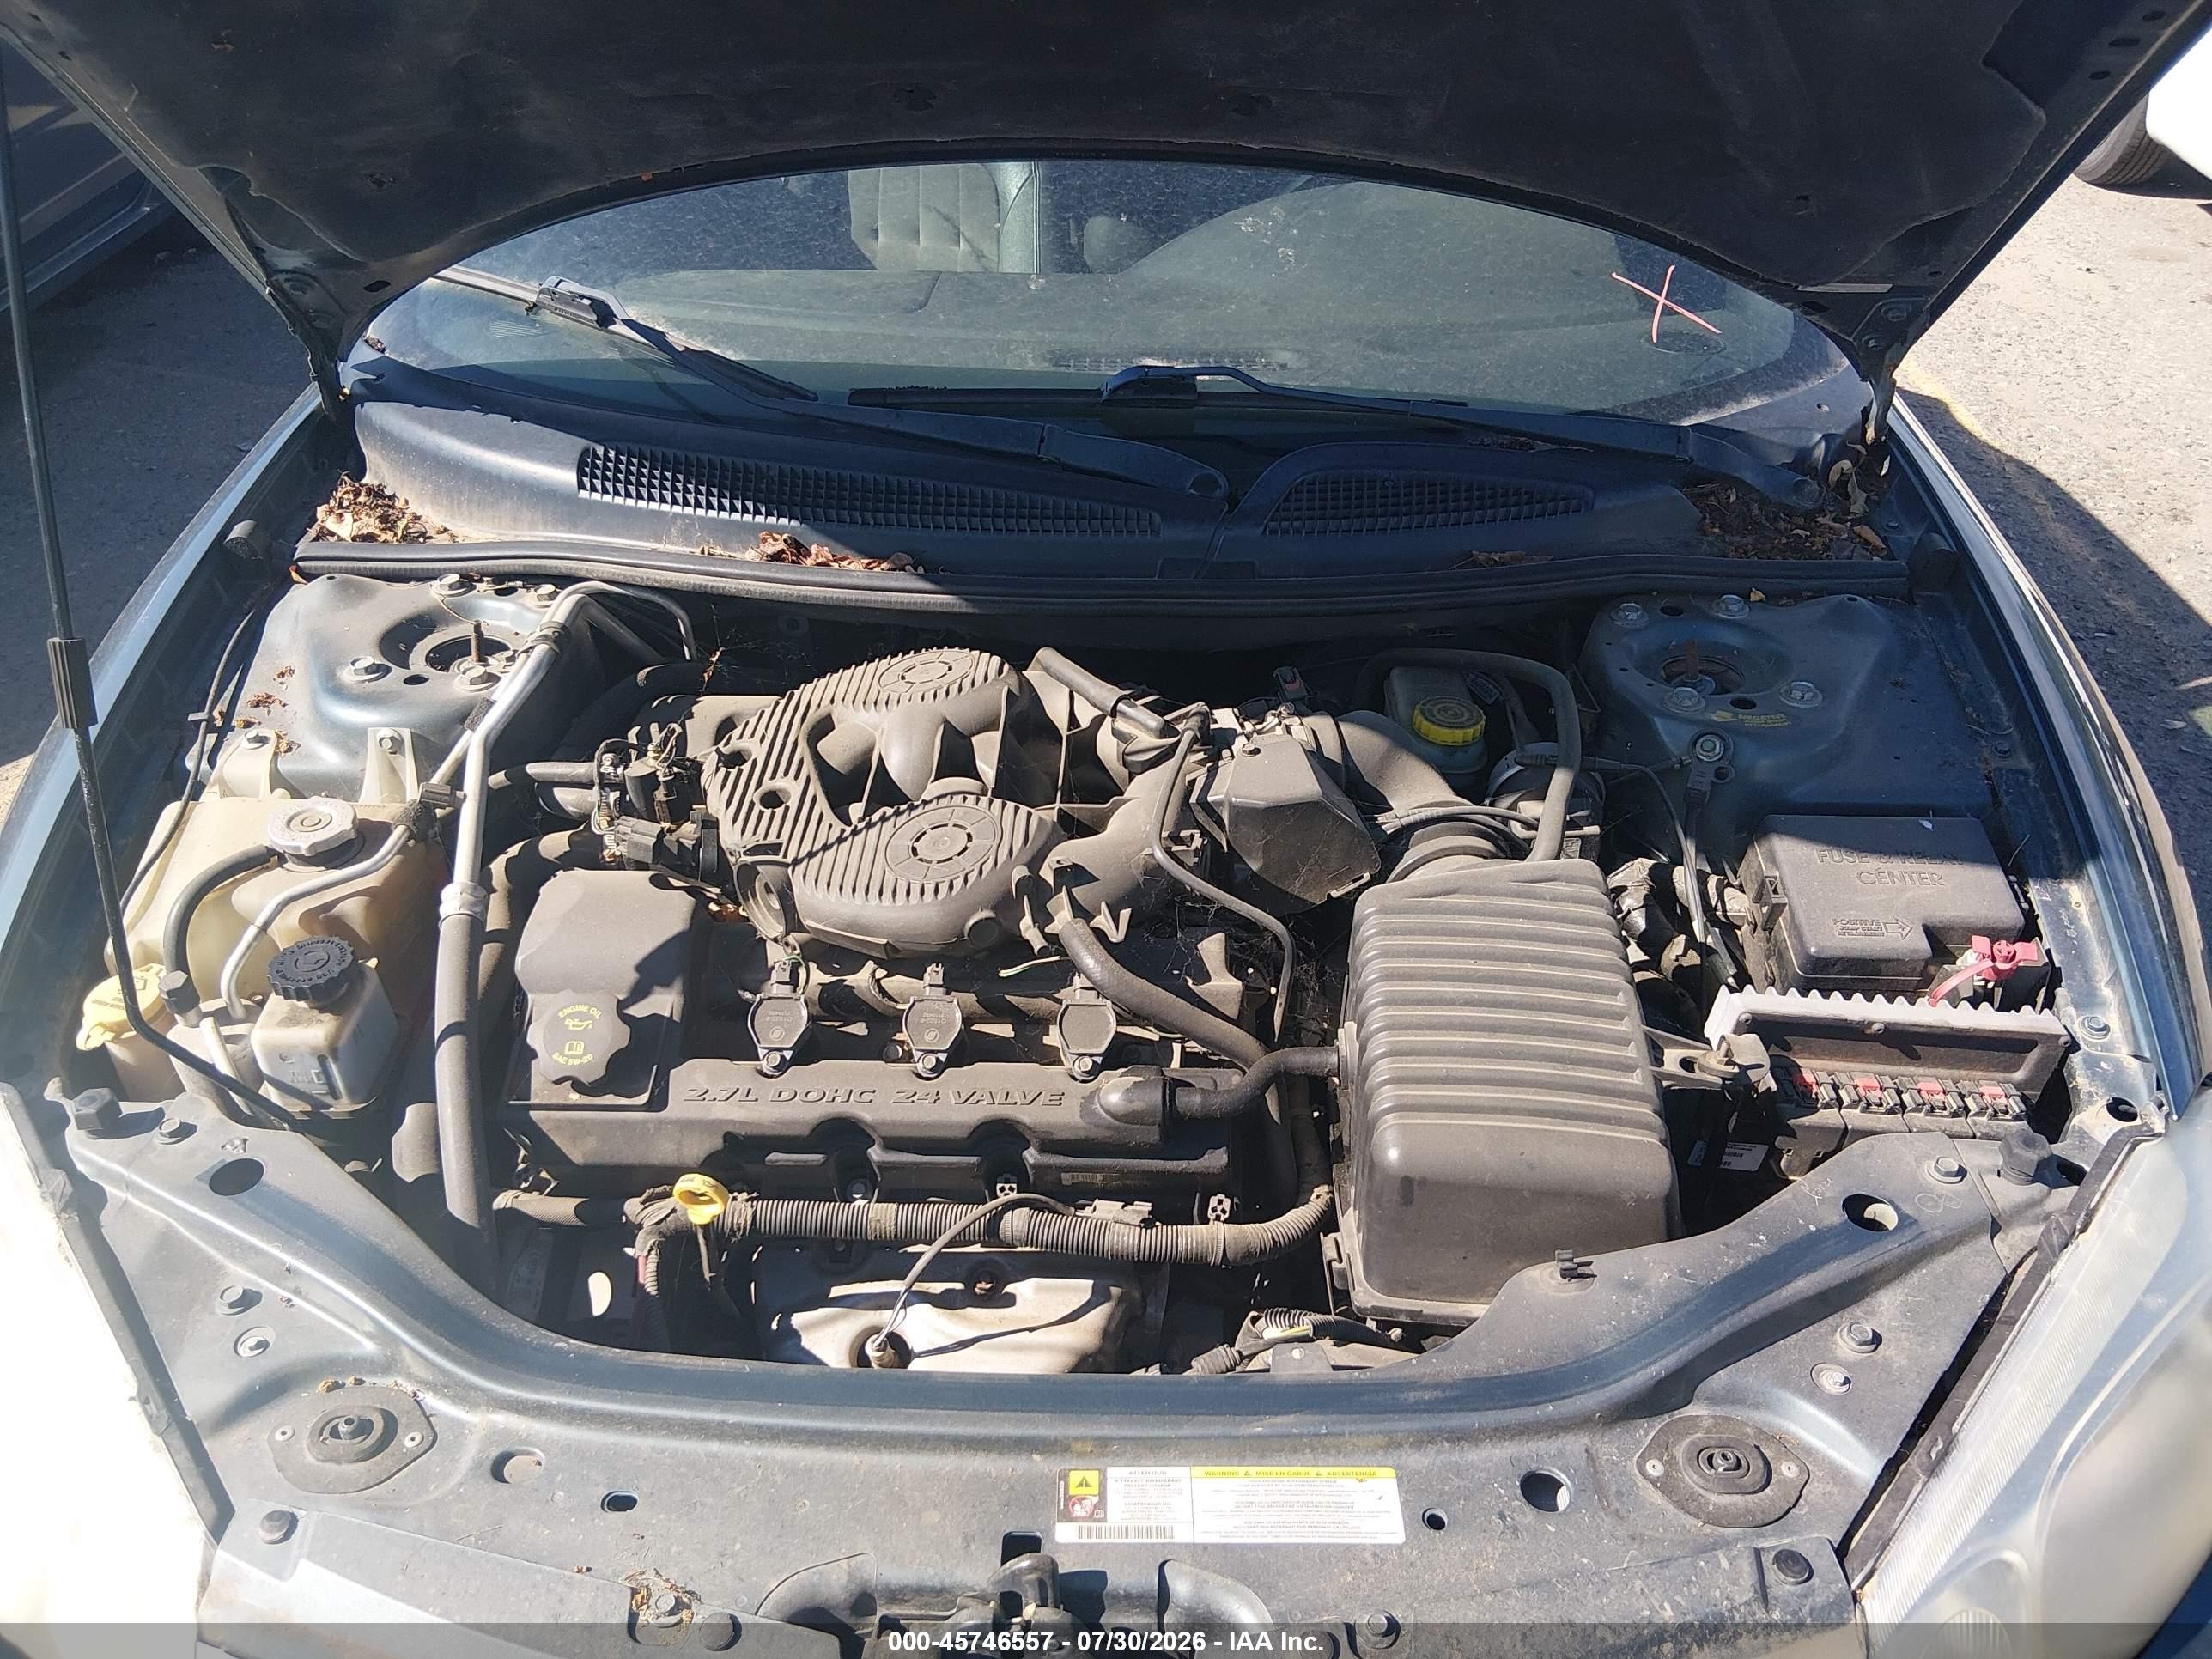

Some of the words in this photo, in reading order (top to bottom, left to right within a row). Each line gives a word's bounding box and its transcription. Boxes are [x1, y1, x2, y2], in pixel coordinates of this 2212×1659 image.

[1814, 848, 1870, 864] FUSE
[558, 1005, 590, 1018] ENGINE
[589, 1008, 602, 1019] OIL
[551, 1052, 567, 1065] SAE
[684, 1086, 758, 1103] 2.7L
[770, 1087, 876, 1104] DOHC
[892, 1088, 941, 1105] 24
[949, 1089, 1065, 1107] VALVE
